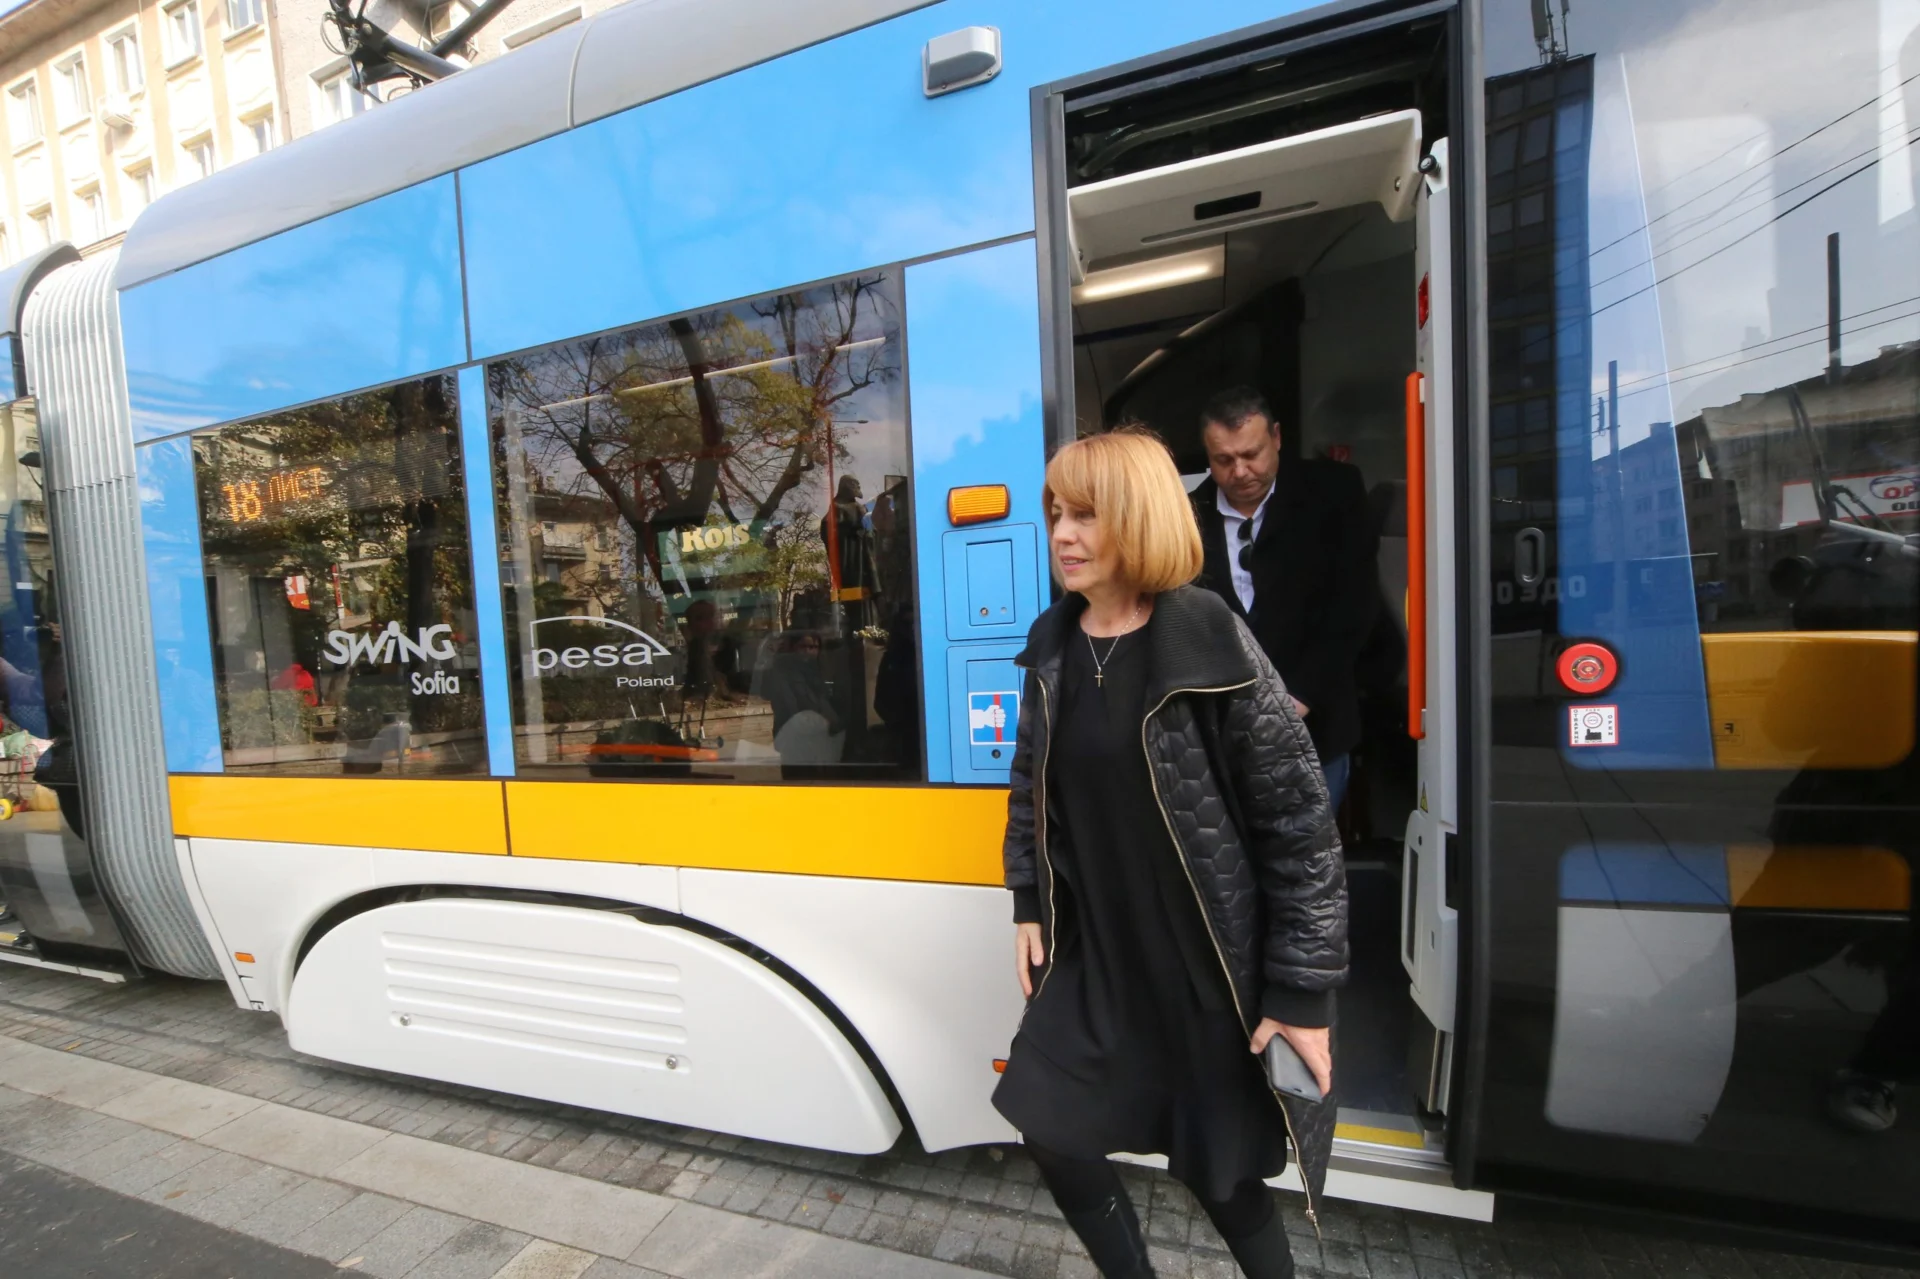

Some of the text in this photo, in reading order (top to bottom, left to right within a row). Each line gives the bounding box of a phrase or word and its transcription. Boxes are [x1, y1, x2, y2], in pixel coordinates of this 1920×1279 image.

[222, 480, 261, 522] 18
[532, 642, 653, 677] pesa
[411, 670, 460, 696] Sofia
[616, 675, 675, 688] Poland
